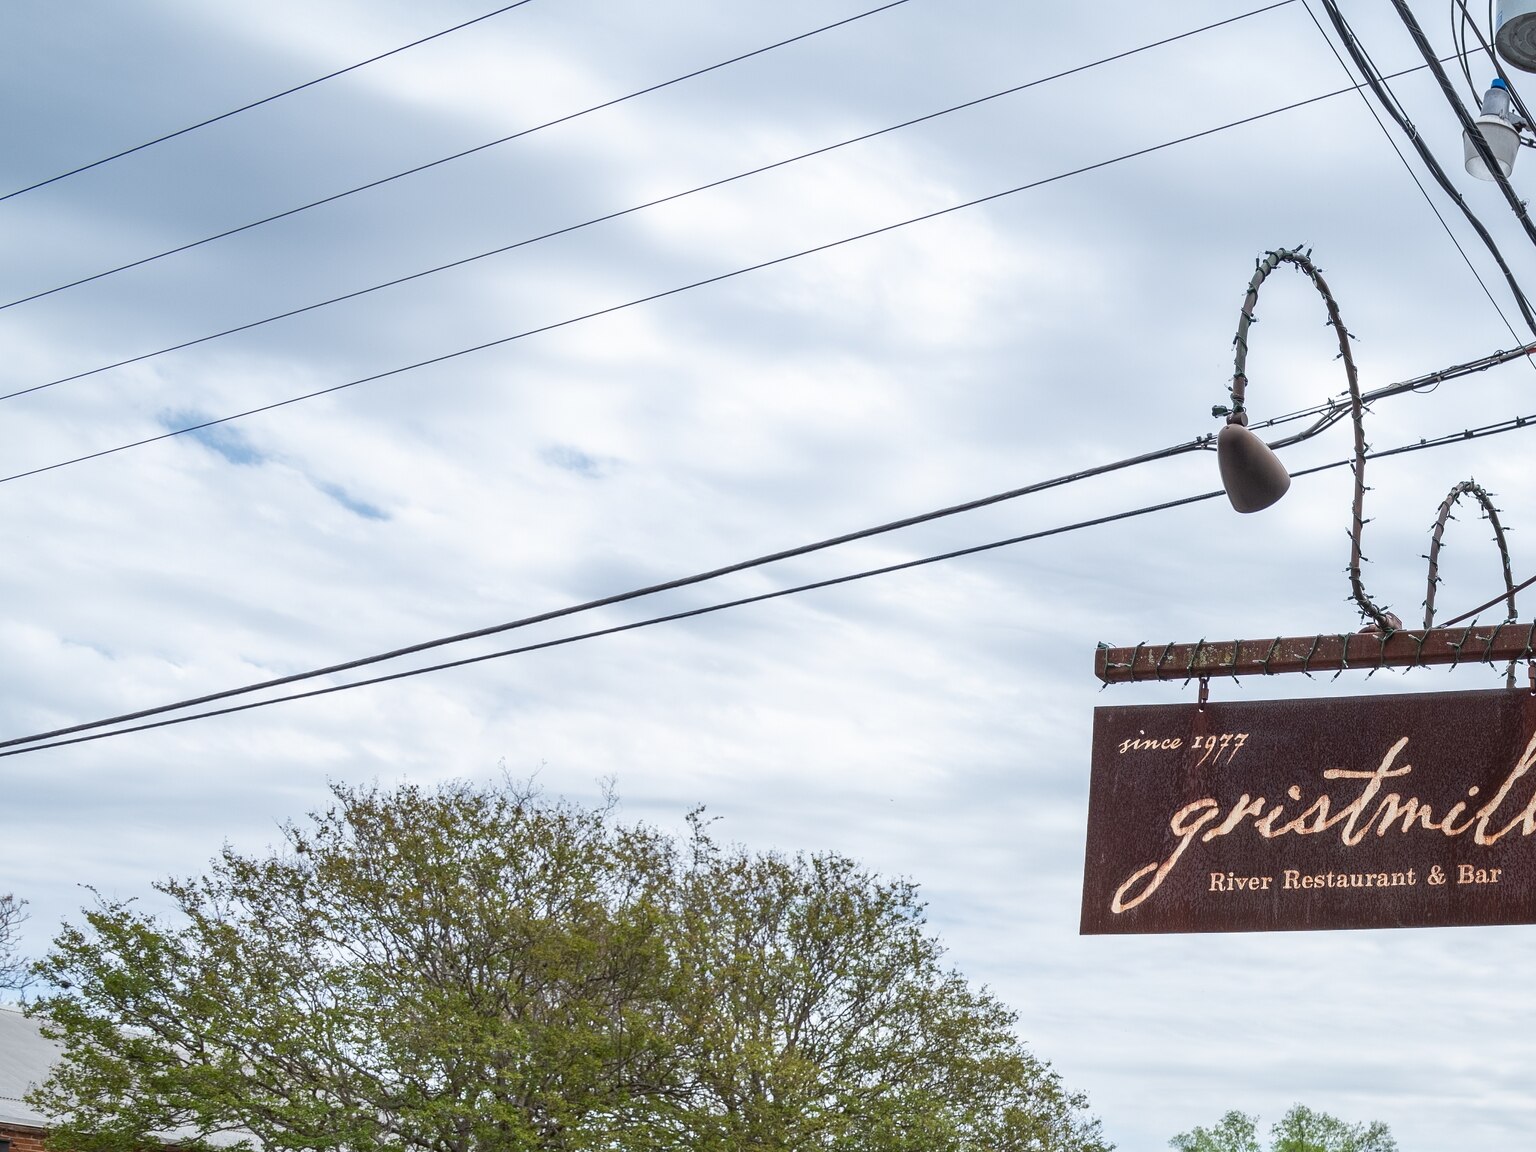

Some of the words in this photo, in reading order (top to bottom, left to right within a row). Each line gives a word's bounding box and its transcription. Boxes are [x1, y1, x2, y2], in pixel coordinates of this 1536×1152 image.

[1118, 729, 1183, 754] since
[1191, 732, 1249, 768] 1977
[1208, 871, 1273, 892] River
[1282, 867, 1417, 890] Restaurant
[1426, 864, 1446, 886] &
[1456, 864, 1502, 885] Bar
